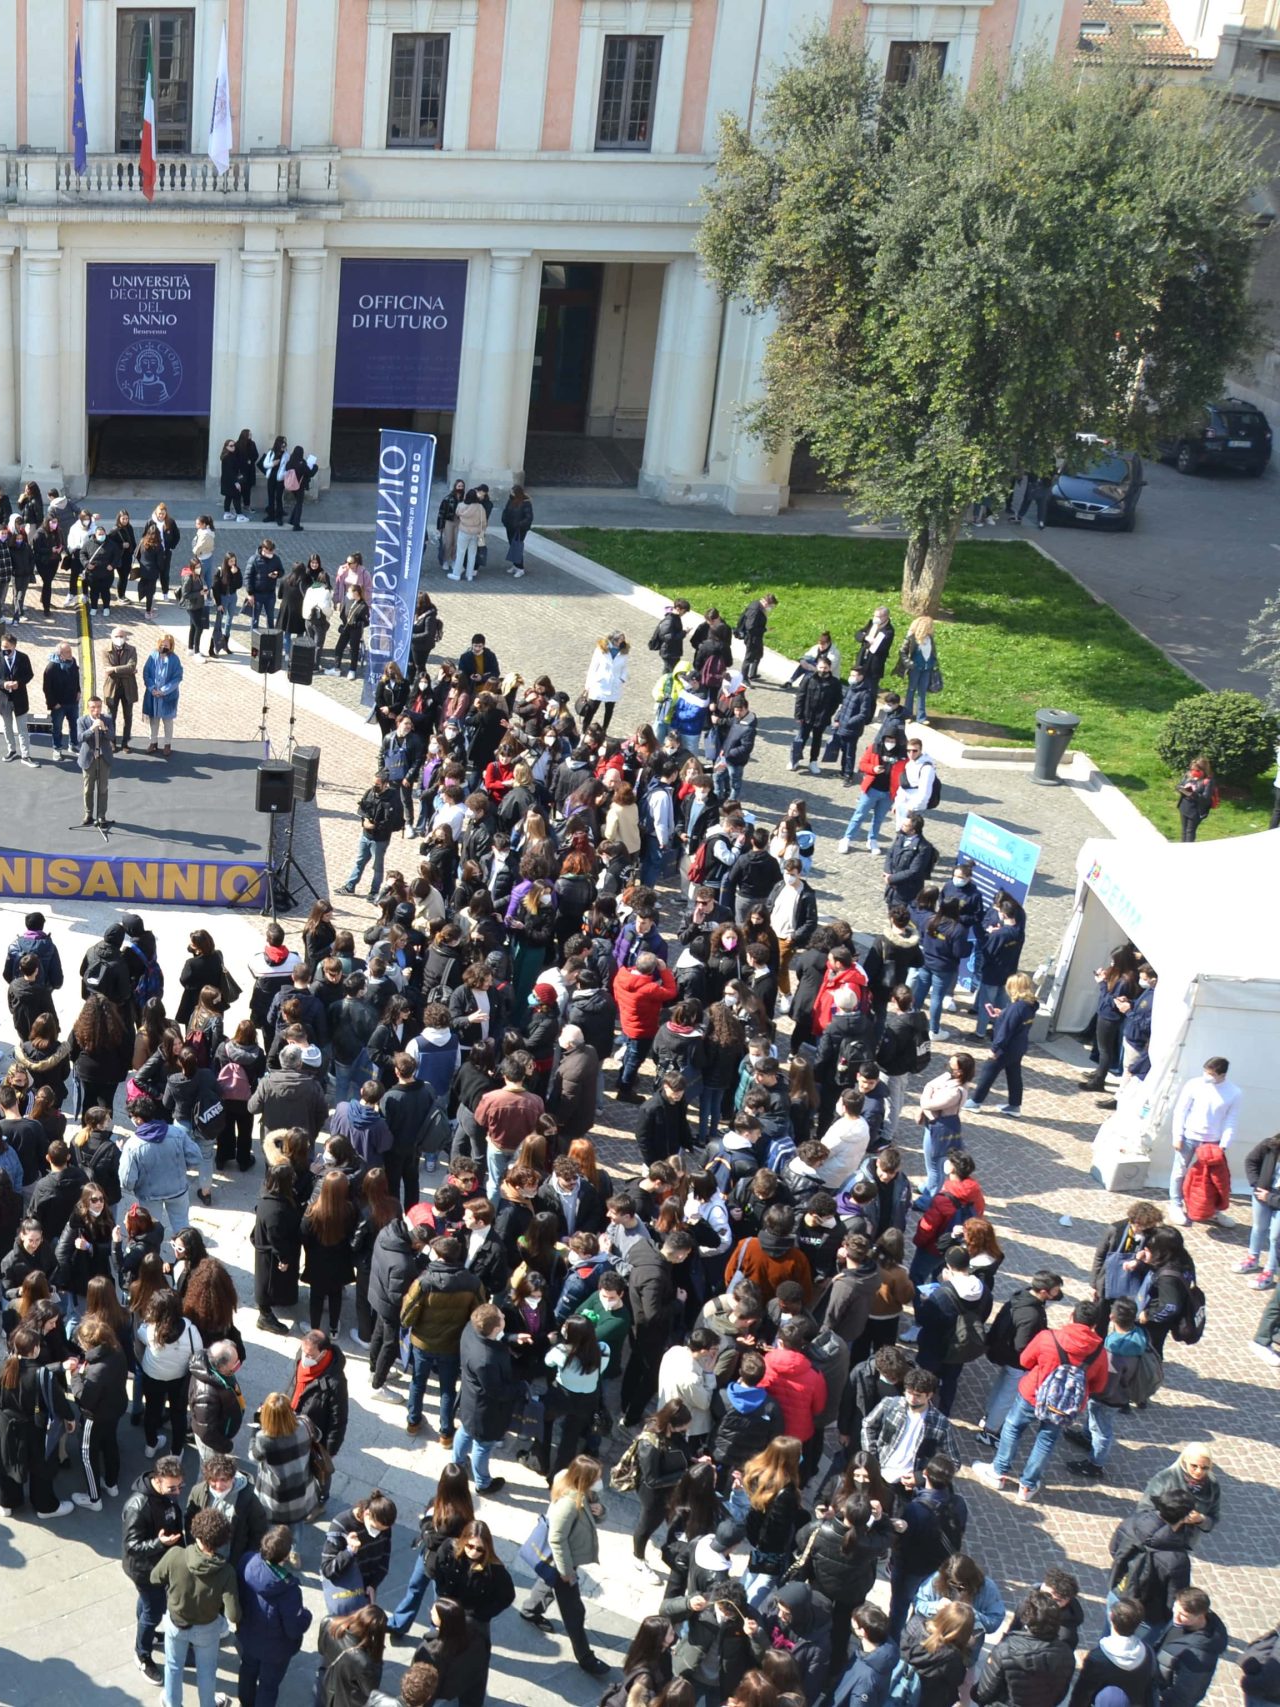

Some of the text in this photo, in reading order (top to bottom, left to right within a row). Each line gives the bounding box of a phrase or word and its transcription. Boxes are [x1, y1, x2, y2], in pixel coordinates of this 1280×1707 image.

[112, 274, 191, 288] UNIVERSITÀ
[110, 288, 191, 301] DEGLI STUDI
[138, 301, 163, 313] DEL
[358, 294, 445, 311] OFFICINA
[122, 313, 178, 326] SANNIO
[352, 314, 448, 330] DI FUTURO
[198, 1101, 224, 1124] VANS
